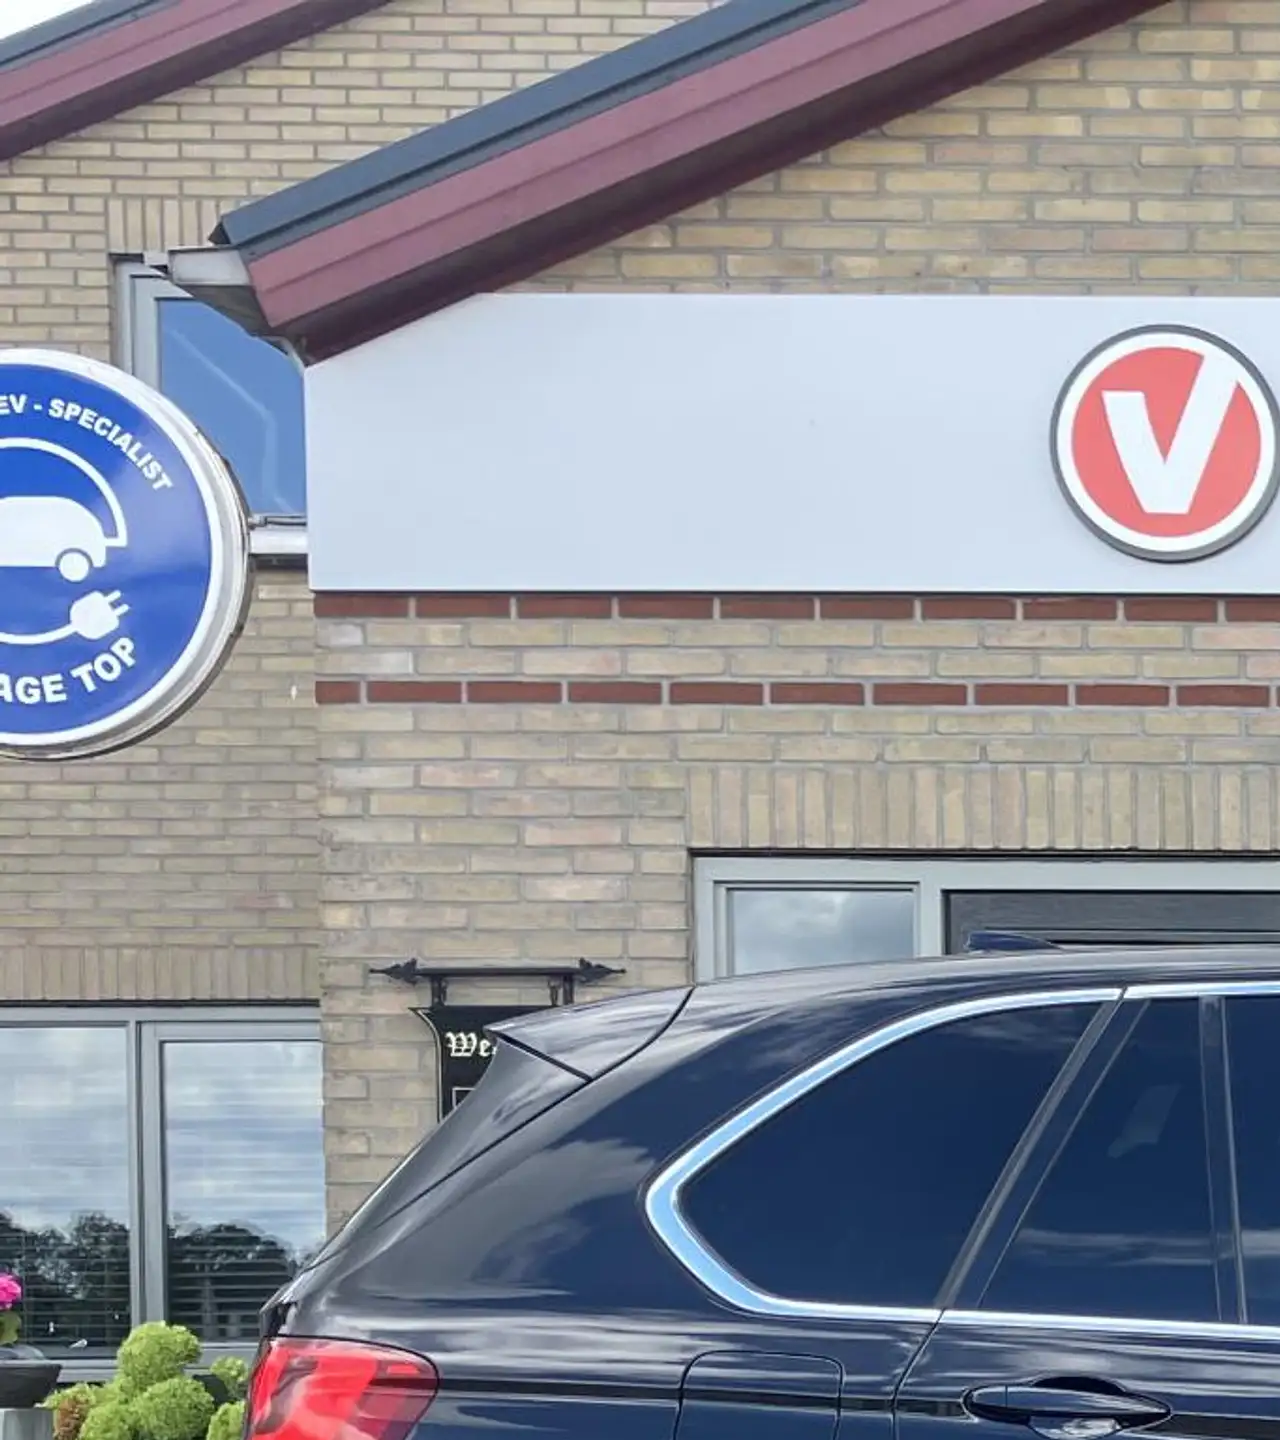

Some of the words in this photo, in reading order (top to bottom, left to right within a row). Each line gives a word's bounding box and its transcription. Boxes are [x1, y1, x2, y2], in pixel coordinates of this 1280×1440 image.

[48, 397, 174, 491] SPECIALIST
[69, 636, 136, 693] TOP
[445, 1031, 498, 1057] We
